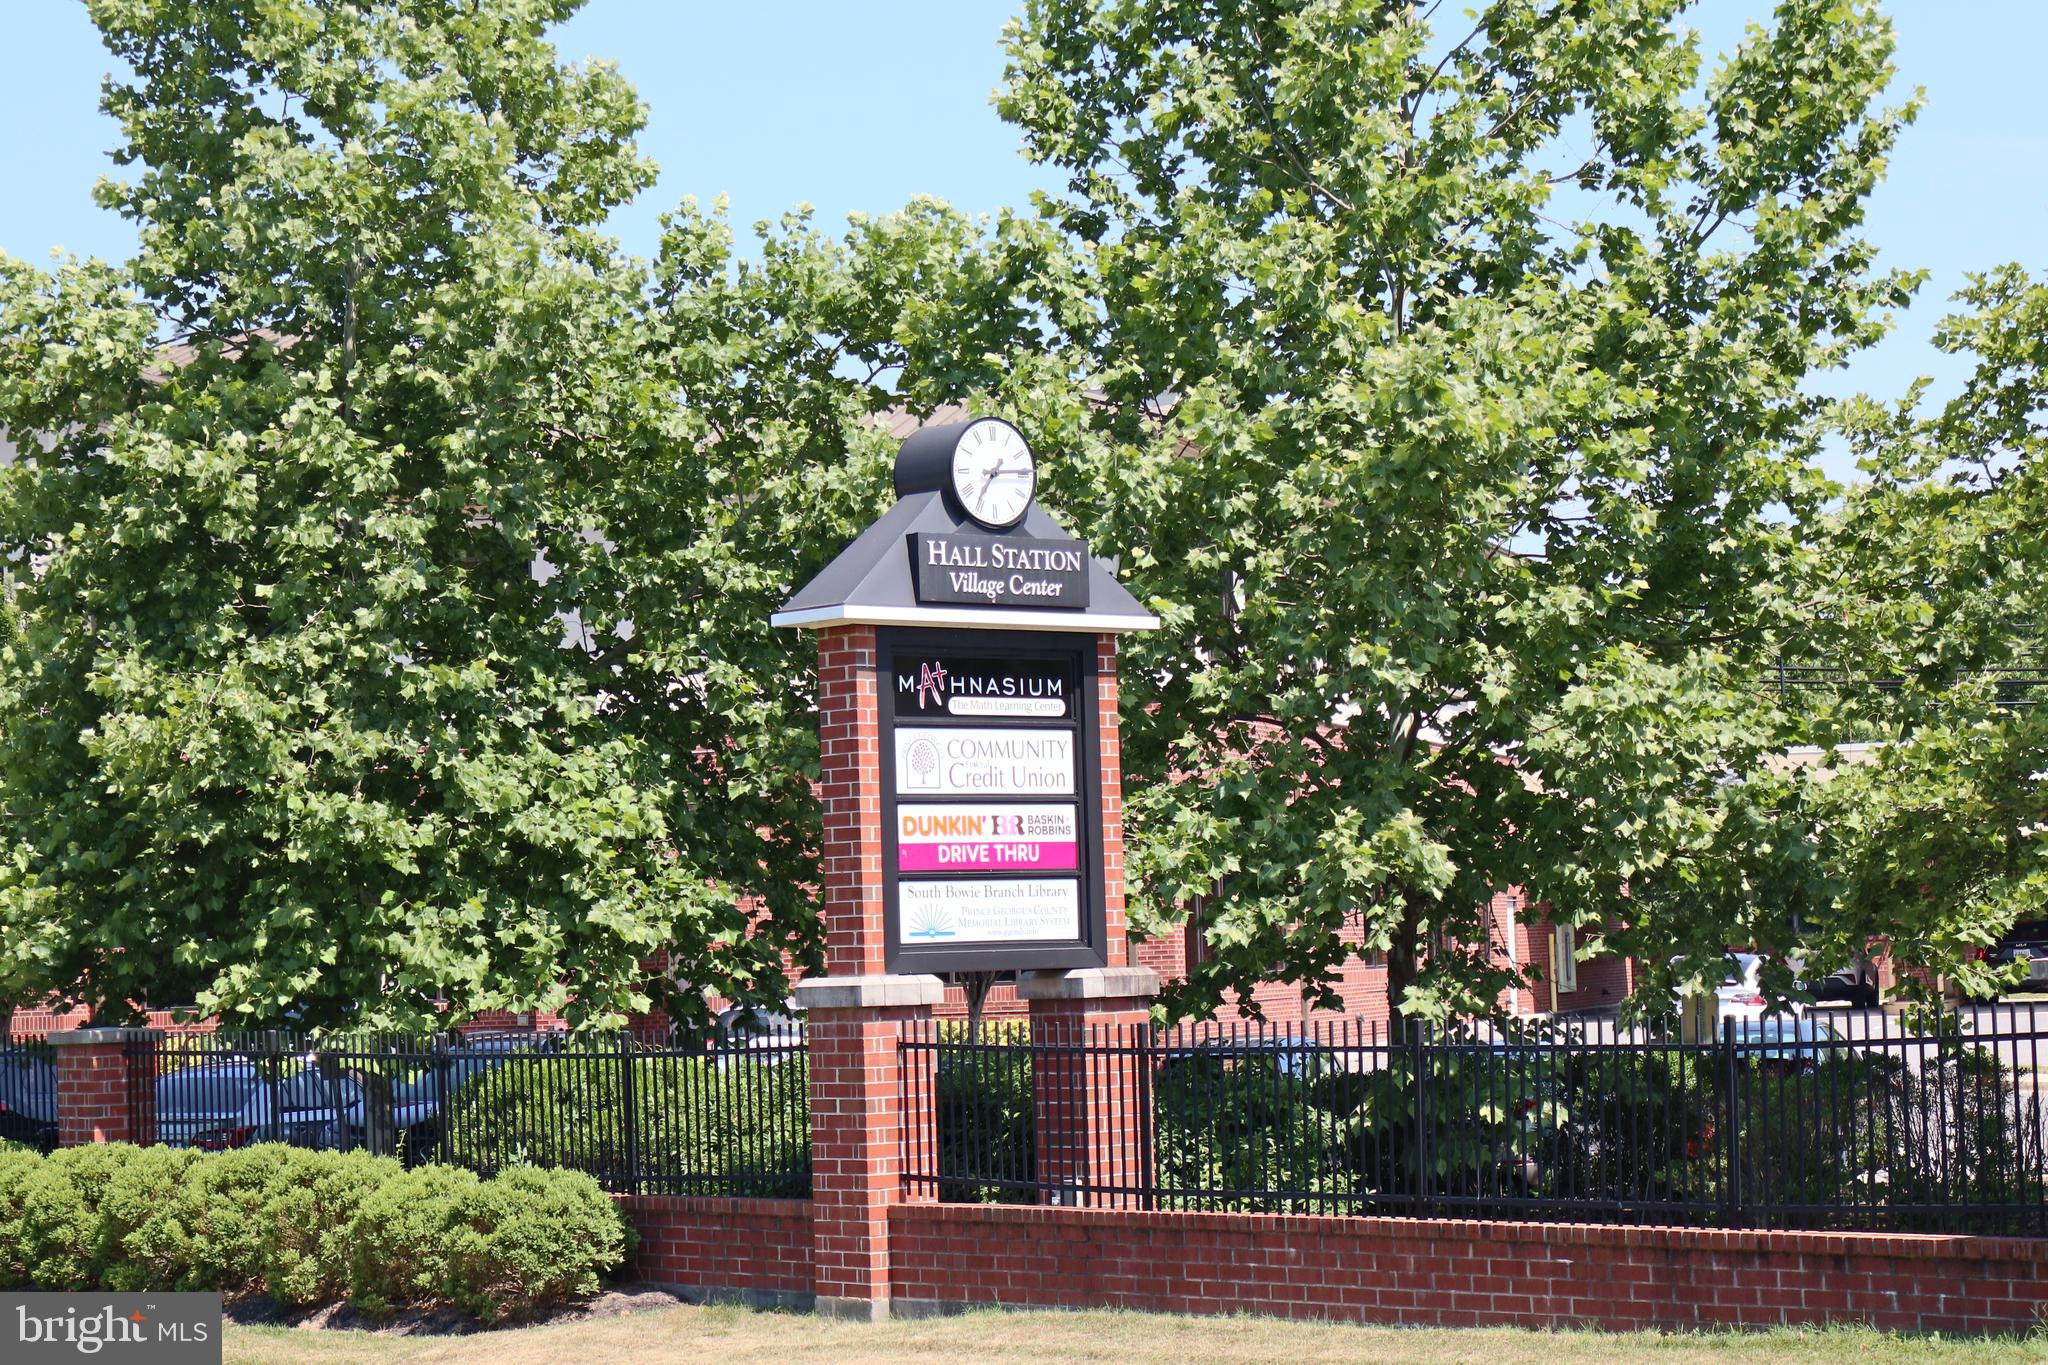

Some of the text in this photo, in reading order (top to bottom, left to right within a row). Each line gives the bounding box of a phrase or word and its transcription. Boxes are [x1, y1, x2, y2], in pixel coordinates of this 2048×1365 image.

[926, 540, 1082, 572] HALL STATION
[949, 572, 1063, 598] Village Center
[952, 700, 1061, 713] The Math Learning Center
[947, 739, 1068, 759] COMMUNITY
[949, 762, 1066, 789] Credit Union
[902, 815, 987, 837] DUNKIN'
[1027, 815, 1065, 825] BASKIN
[1027, 826, 1072, 836] ROBBINS
[938, 843, 1040, 864] DRIVE THRU
[907, 883, 1069, 899] South Bowie Branch Library
[958, 916, 1070, 928] MEMORIAL LIBRARY SYSTEM
